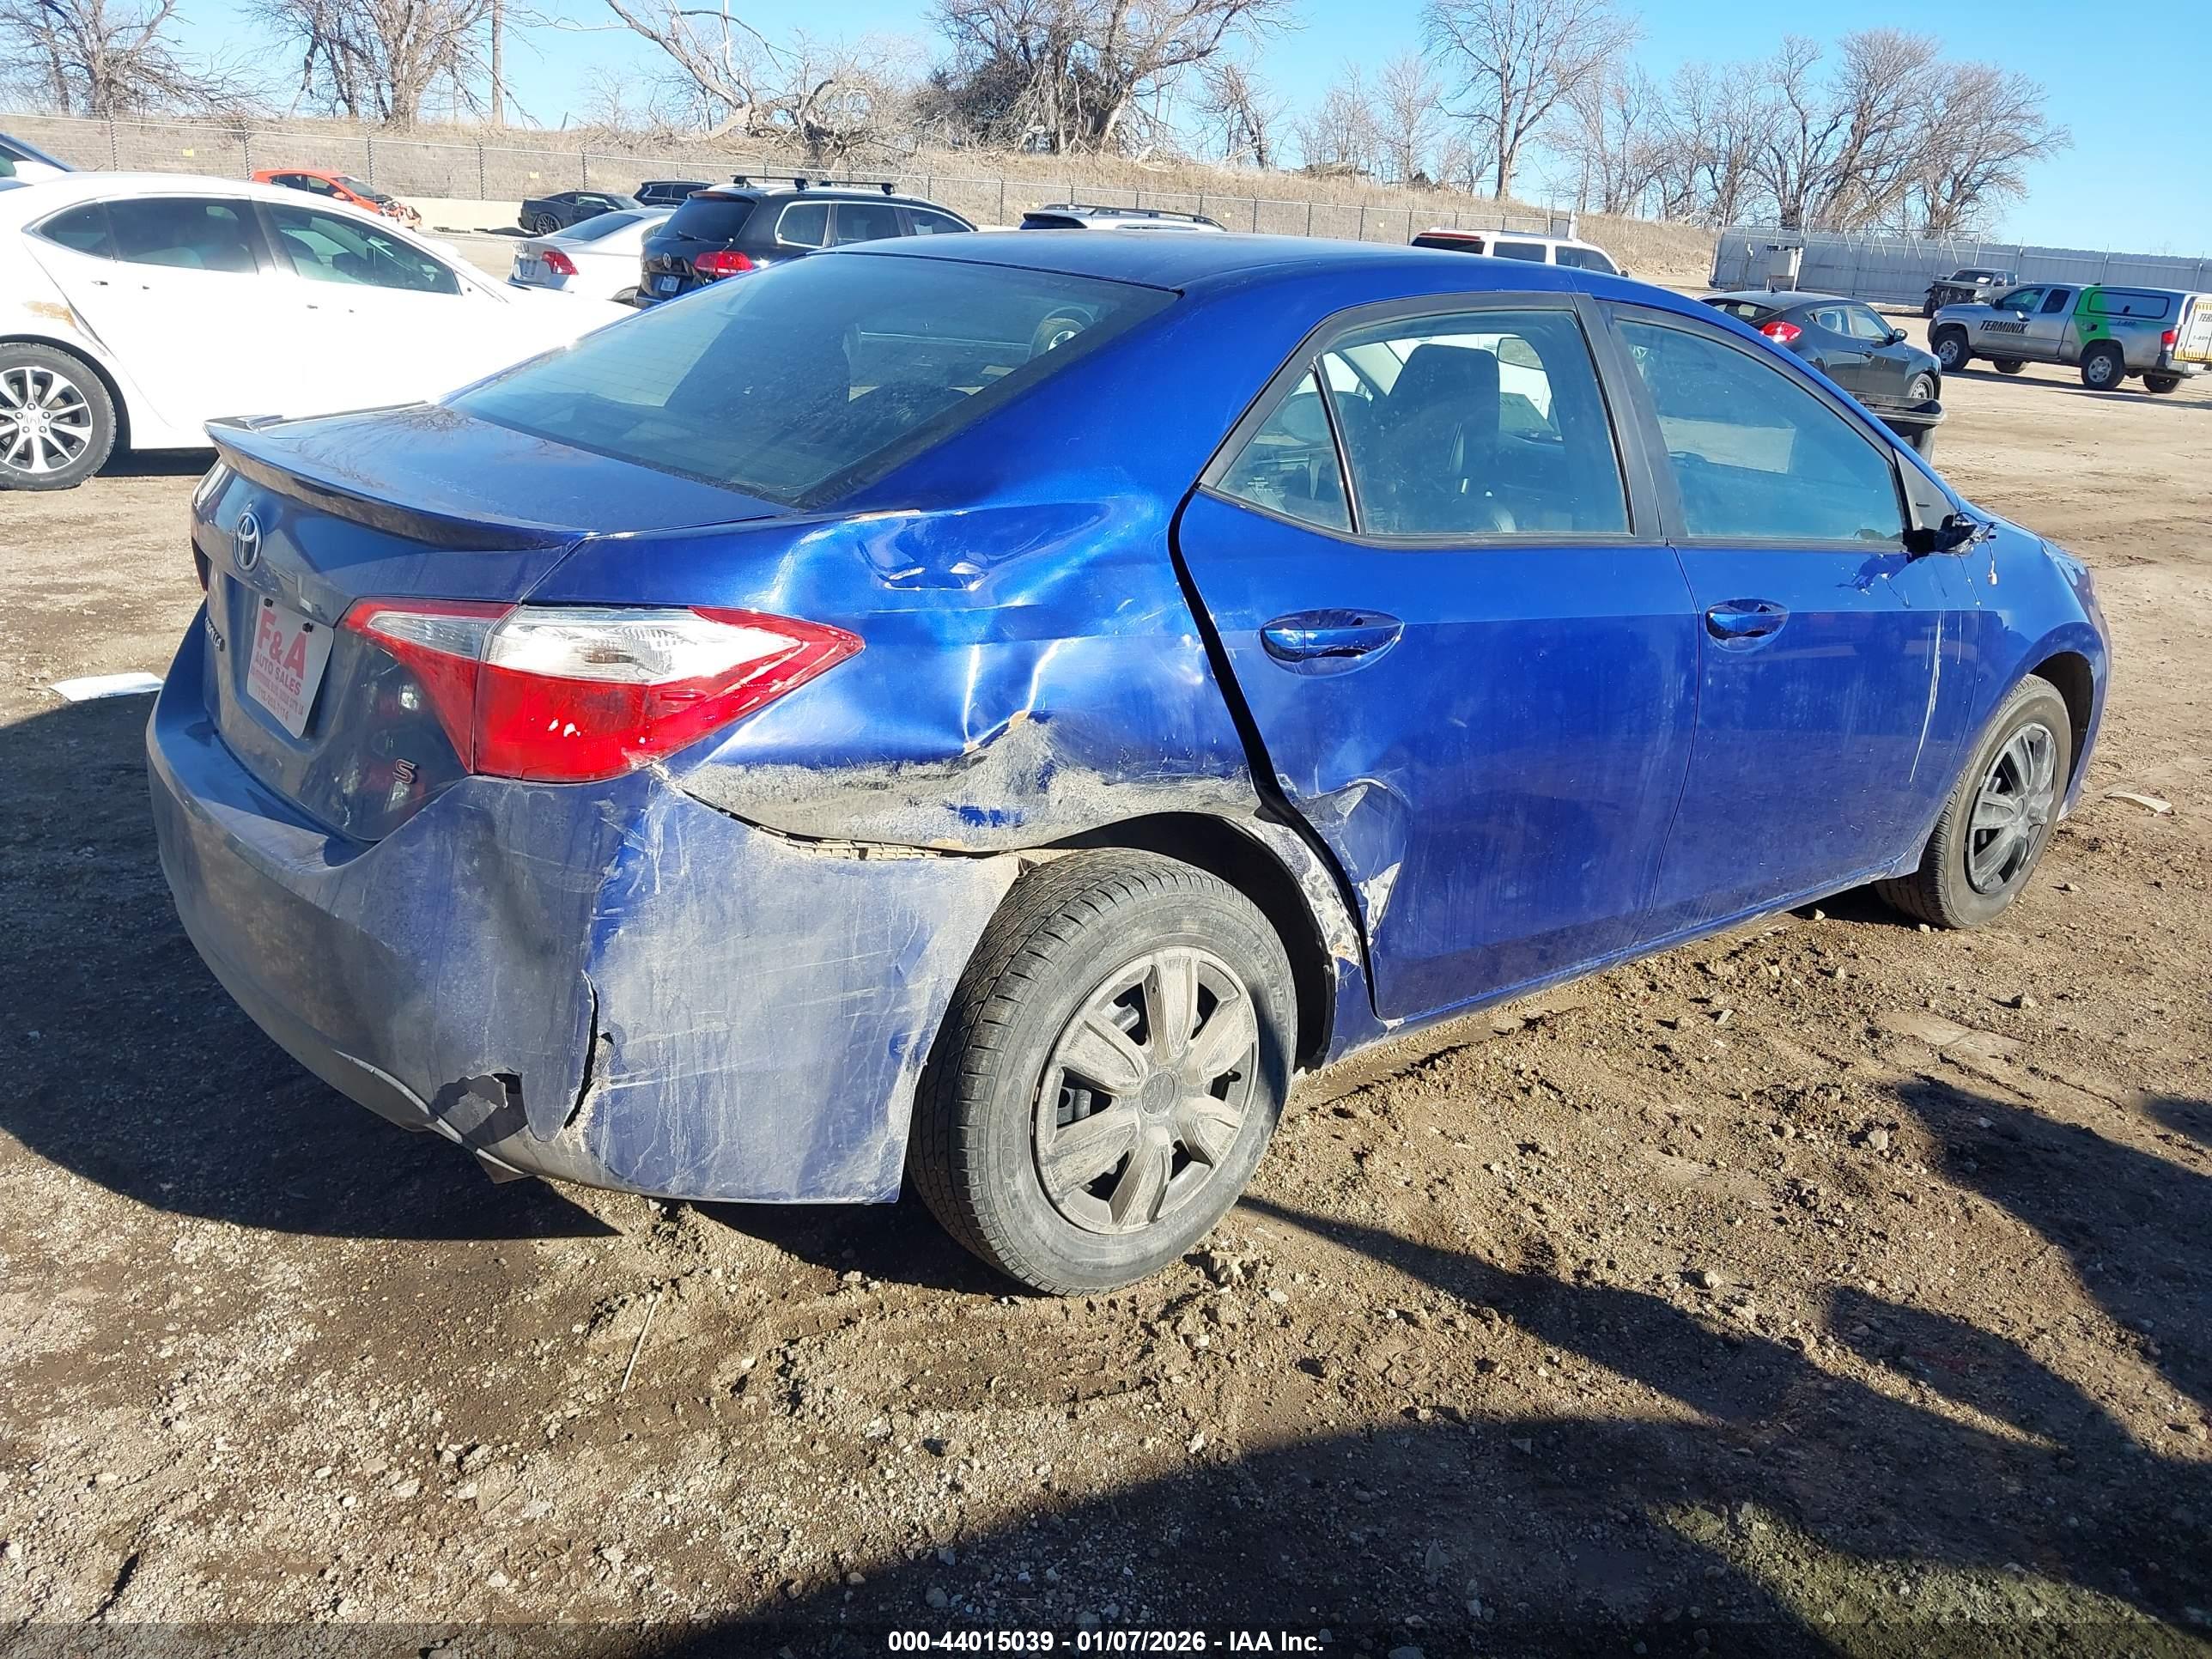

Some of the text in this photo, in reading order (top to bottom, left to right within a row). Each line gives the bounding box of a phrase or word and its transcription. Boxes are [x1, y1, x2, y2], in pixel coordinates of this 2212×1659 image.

[1979, 319, 2028, 334] TERMINIX
[258, 607, 307, 680] F&A
[255, 652, 274, 675] AUTO
[276, 667, 301, 696] SALES
[392, 759, 415, 784] S
